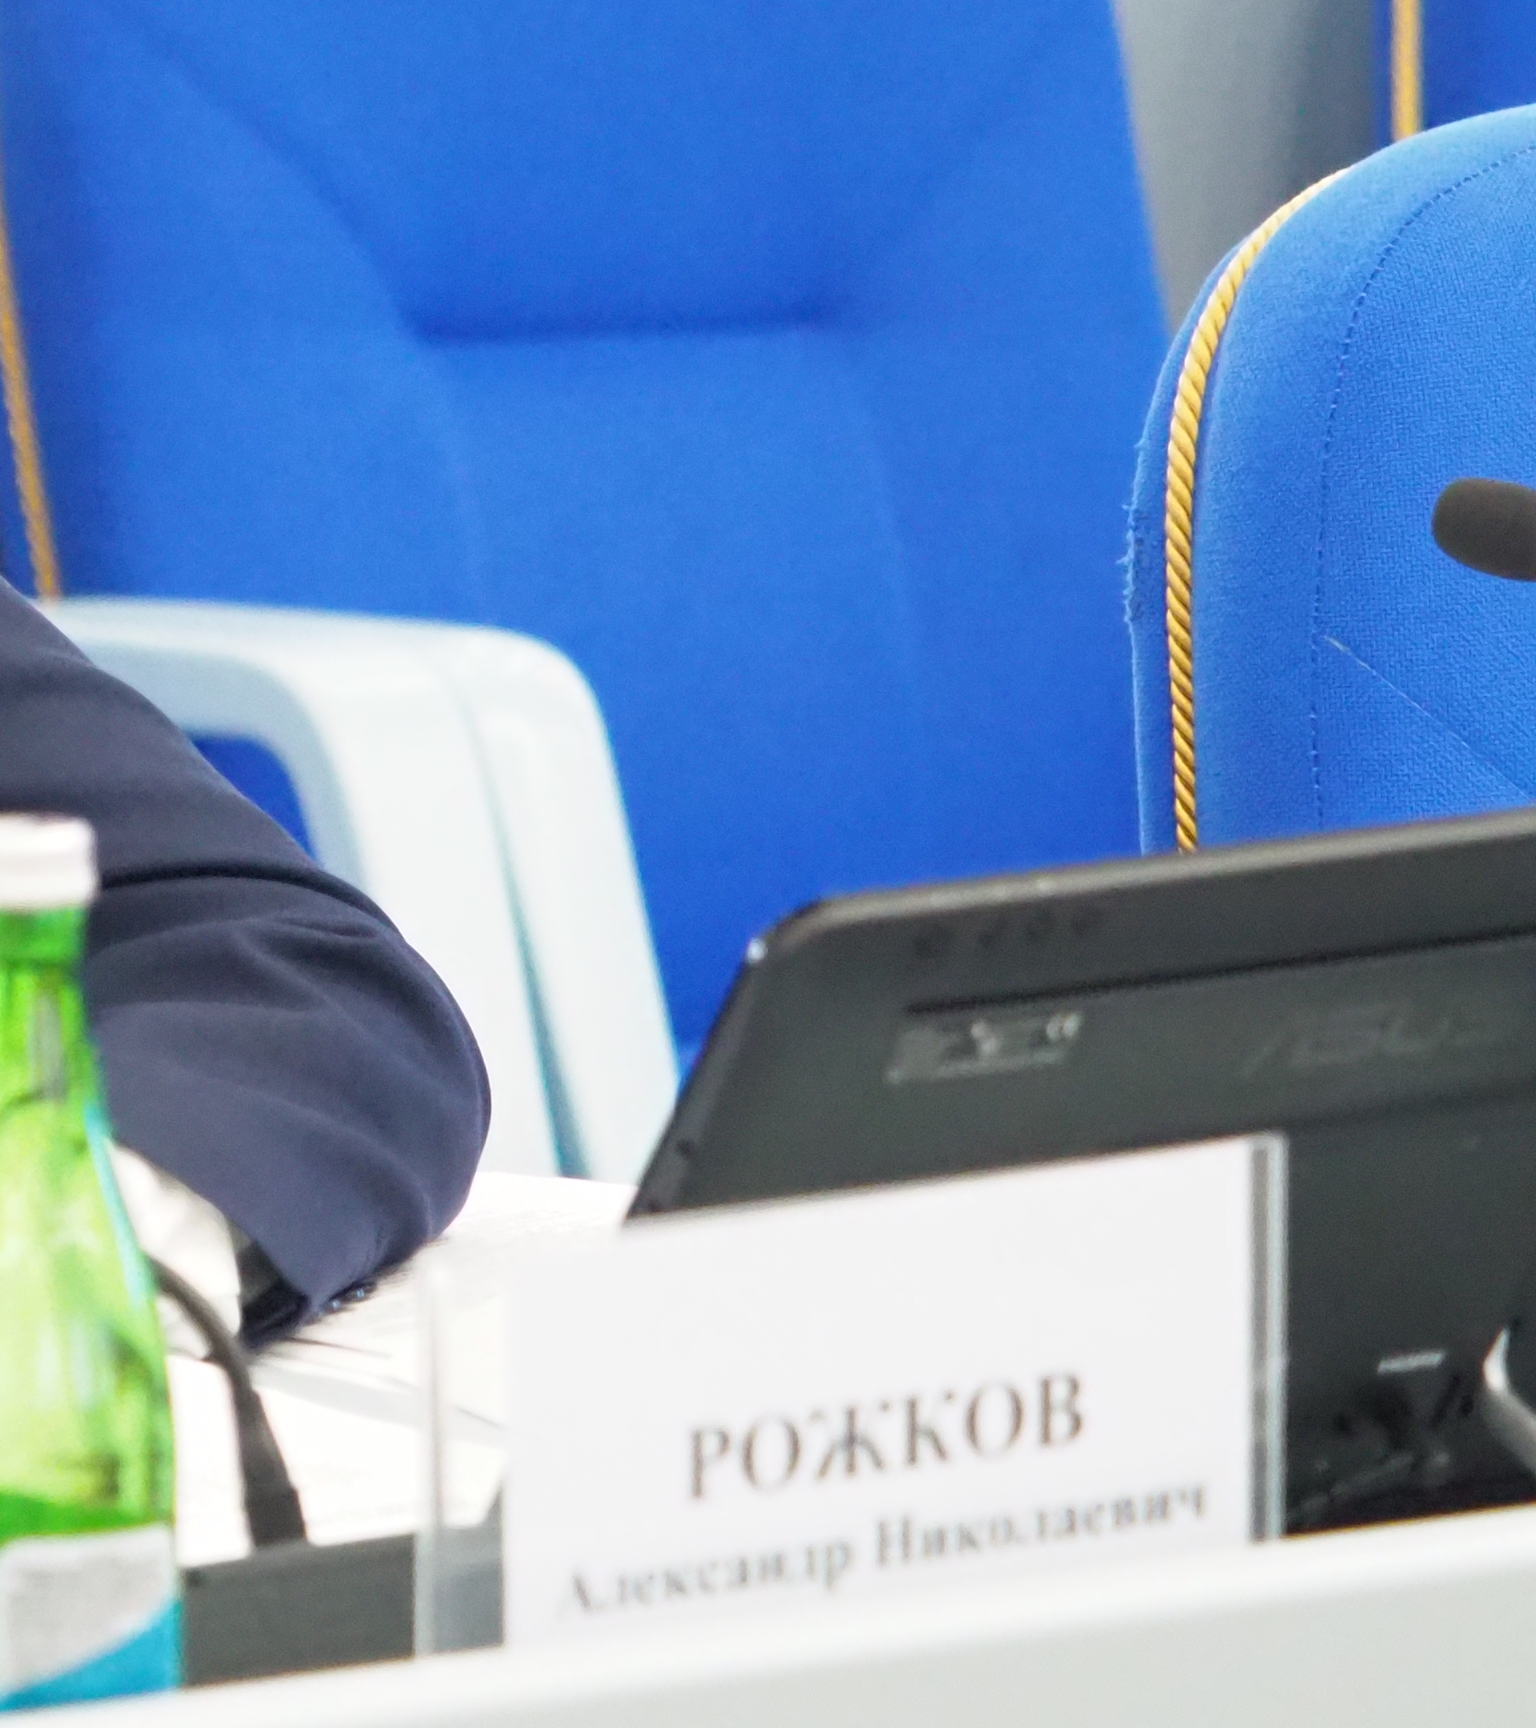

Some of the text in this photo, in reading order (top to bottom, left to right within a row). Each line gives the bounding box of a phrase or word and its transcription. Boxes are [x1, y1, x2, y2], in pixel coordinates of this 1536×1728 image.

[686, 1369, 1086, 1501] РОЖКОВ
[556, 1484, 1206, 1618] Александр Николаевич
